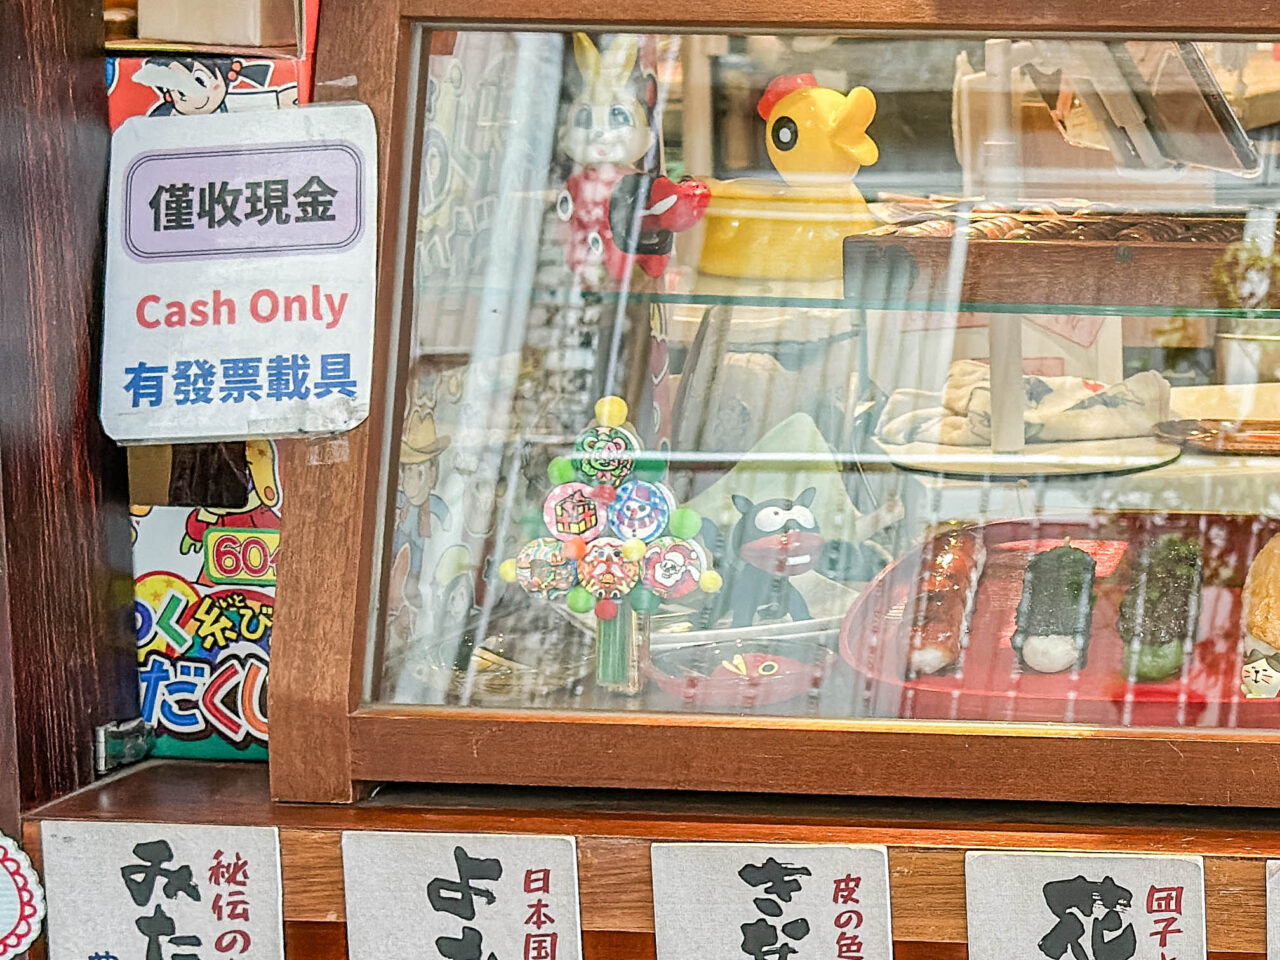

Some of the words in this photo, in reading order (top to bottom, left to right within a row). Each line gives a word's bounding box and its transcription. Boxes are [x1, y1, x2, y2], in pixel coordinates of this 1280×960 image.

[148, 175, 338, 232] 僅收現金
[136, 290, 236, 329] Cash
[249, 285, 348, 328] Only
[123, 353, 358, 408] 有發票載具
